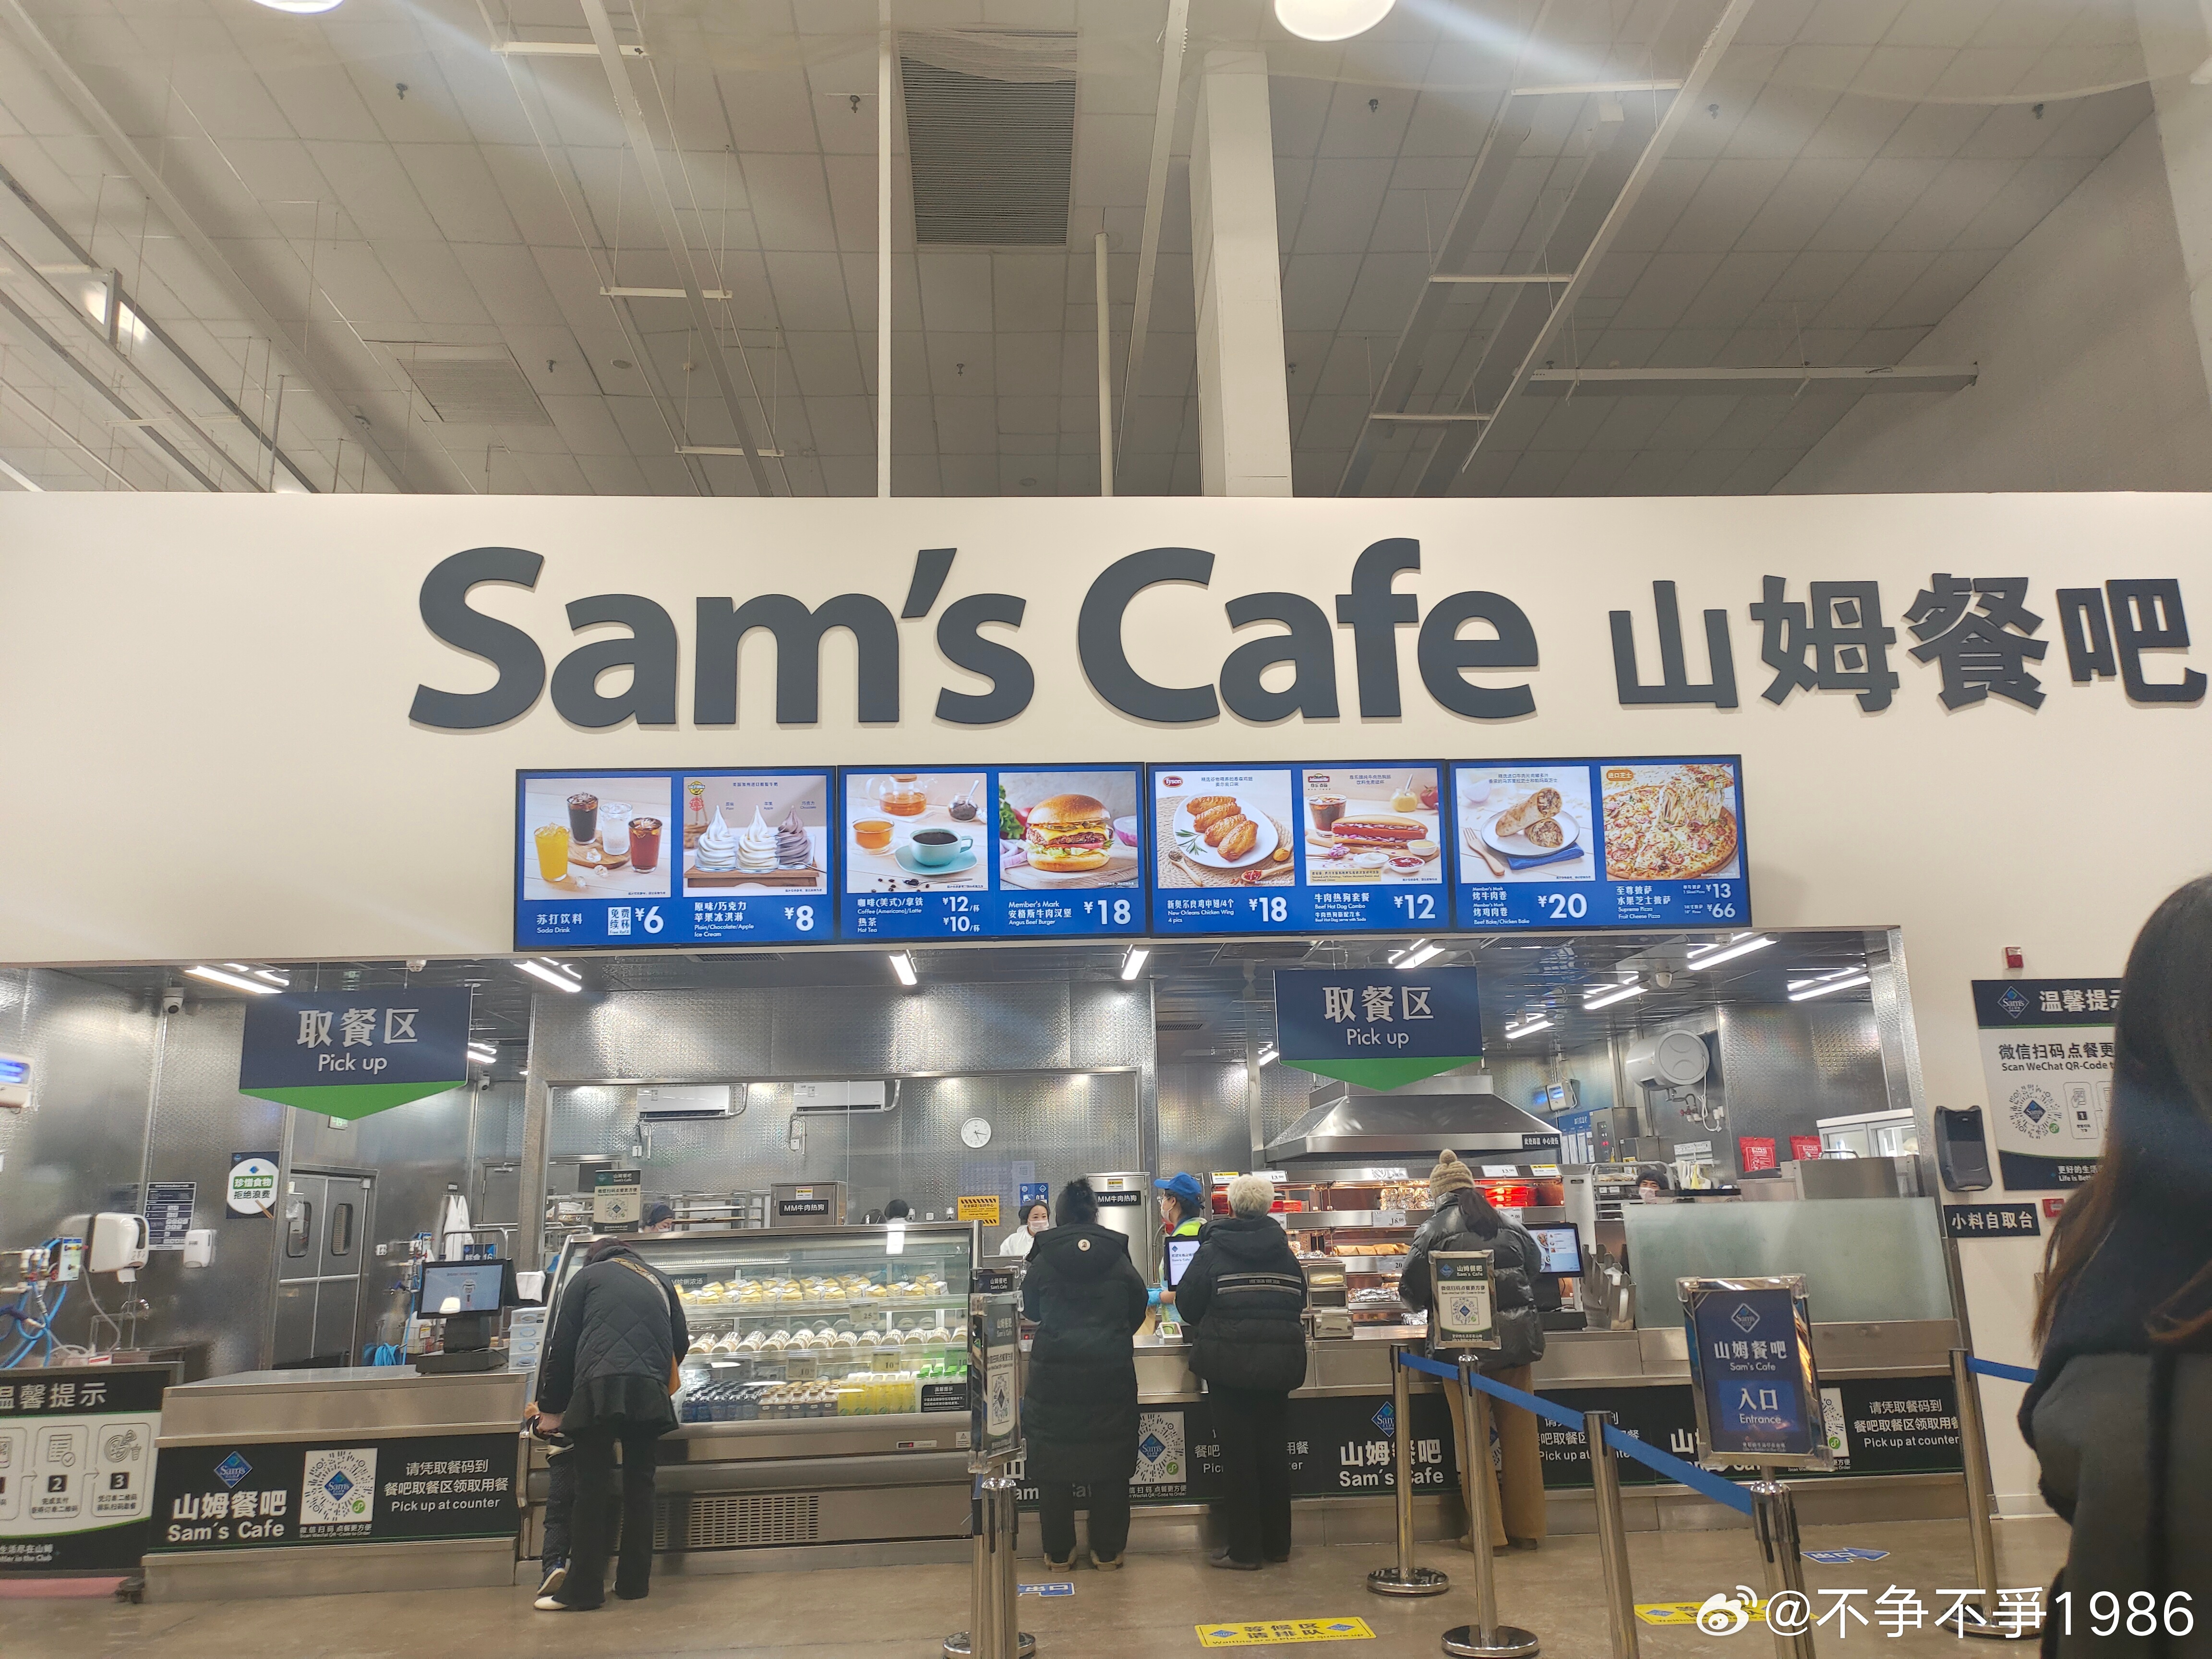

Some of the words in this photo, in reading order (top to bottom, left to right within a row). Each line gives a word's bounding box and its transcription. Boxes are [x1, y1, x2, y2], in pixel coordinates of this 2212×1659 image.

[409, 547, 1034, 729] Sam's
[1078, 538, 1538, 722] Cafe
[1609, 573, 2207, 712] 山姆餐吧
[1314, 892, 1370, 902] 牛肉热狗套餐
[1472, 891, 1508, 901] 烤牛肉卷
[1616, 885, 1653, 896] 至尊披萨
[1706, 883, 1731, 898] ¥13
[694, 902, 746, 911] 原味/巧克力
[1394, 894, 1436, 919] ¥12
[1538, 893, 1587, 918] ¥20
[1617, 895, 1671, 906] 水果芝士披萨
[694, 912, 743, 922] 苹果冰淇淋
[1009, 908, 1072, 919] 安格斯牛肉汉堡
[1083, 899, 1131, 925] ¥18
[1249, 897, 1287, 922] ¥18
[1473, 907, 1508, 917] 烤鸡肉卷
[1707, 903, 1736, 918] ¥66
[536, 913, 583, 925] 苏打饮料
[635, 906, 664, 934] ¥6
[784, 905, 814, 931] ¥8
[857, 917, 877, 926] 热茶
[1322, 986, 1434, 1023] 取餐区
[297, 1008, 419, 1048] 取餐区
[1346, 1027, 1382, 1046] Pick
[1387, 1032, 1409, 1049] up
[1998, 1042, 2114, 1060] 微信扫码点餐更
[318, 1052, 357, 1072] Pick
[363, 1057, 387, 1075] up
[2002, 1062, 2024, 1071] Scan
[2026, 1061, 2063, 1070] WeChat
[2066, 1061, 2107, 1070] QR-Code
[234, 1178, 272, 1188] 珍惜食物
[234, 1190, 271, 1199] 拒绝浪费
[1098, 1194, 1137, 1202] MM牛肉热狗
[1951, 1211, 2033, 1230] 小料自取台
[1714, 1341, 1787, 1359] 山姆餐吧
[1730, 1362, 1754, 1371] Sam's
[1755, 1362, 1776, 1371] Cafe
[0, 1382, 107, 1409] 温馨提示
[1739, 1388, 1778, 1410] 入口
[1869, 1399, 1942, 1415] 请凭取餐码到
[1739, 1413, 1781, 1424] Entrance
[1854, 1416, 1959, 1433] 餐吧取餐区领取用餐
[1539, 1431, 1587, 1445] 吧取餐区
[1864, 1436, 1888, 1448] Pick
[1890, 1438, 1903, 1448] up
[1905, 1436, 1916, 1446] at
[1918, 1435, 1960, 1445] counter
[1194, 1444, 1220, 1458] 餐吧
[1539, 1450, 1561, 1461] Pick
[1564, 1452, 1577, 1461] up
[1579, 1450, 1591, 1459] at
[406, 1459, 489, 1476] 请凭取餐码到
[1203, 1463, 1224, 1473] Pic
[52, 1478, 62, 1490] 2
[115, 1475, 124, 1488] 3
[1339, 1468, 1395, 1487] Sam's
[1410, 1467, 1444, 1484] afe
[384, 1477, 508, 1496] 餐吧取餐区领取用餐
[1016, 1487, 1039, 1500] am
[173, 1490, 288, 1520] 山姆餐吧
[392, 1500, 418, 1512] Pick
[421, 1502, 435, 1512] up
[438, 1499, 450, 1510] at
[453, 1498, 500, 1509] counter
[168, 1522, 229, 1542] Sam's
[238, 1519, 285, 1539] Cafe
